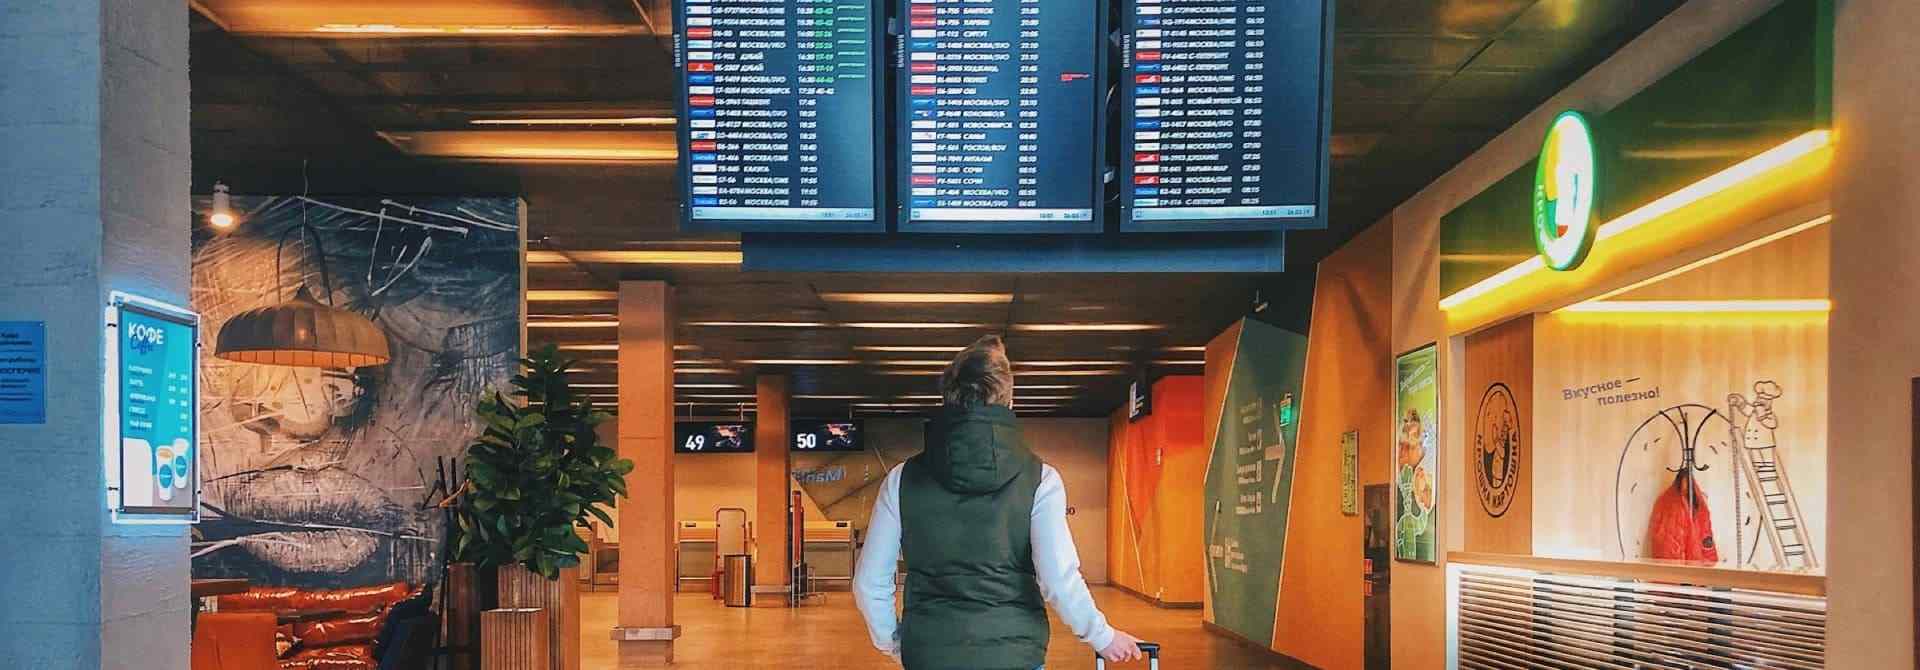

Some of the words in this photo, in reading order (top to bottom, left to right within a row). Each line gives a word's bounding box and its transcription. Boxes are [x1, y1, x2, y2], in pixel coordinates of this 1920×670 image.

[128, 322, 164, 344] КОФЕ
[1562, 379, 1622, 400] Вкусное
[1598, 386, 1660, 406] полезно!
[685, 434, 704, 450] 49
[796, 433, 816, 448] 50
